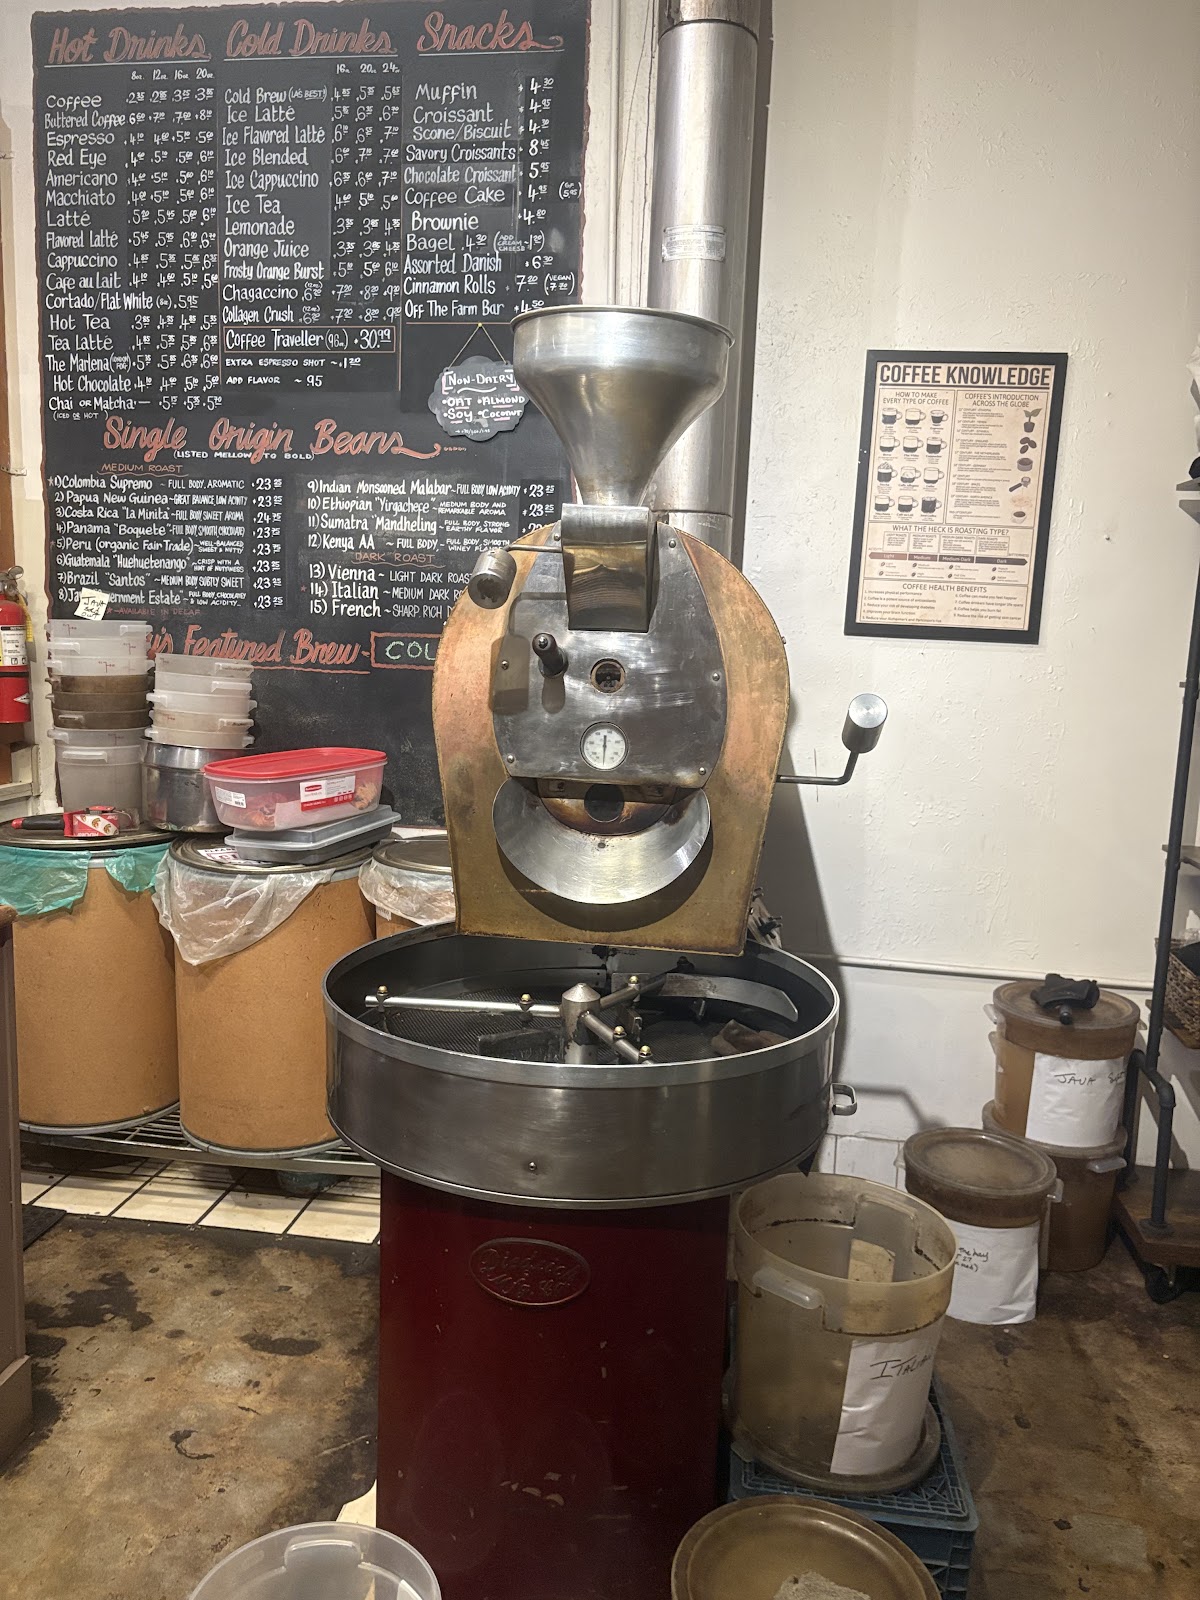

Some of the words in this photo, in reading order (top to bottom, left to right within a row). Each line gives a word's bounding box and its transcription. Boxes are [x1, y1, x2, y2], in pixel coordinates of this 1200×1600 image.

[226, 19, 285, 57] Cold
[289, 17, 397, 56] Drinks
[416, 9, 564, 51] Snacks
[48, 27, 98, 64] Hot
[103, 23, 211, 62] Drinks
[46, 95, 102, 111] Coffee
[224, 88, 251, 104] Cold
[256, 87, 287, 104] Brew
[415, 83, 477, 104] Muffin
[45, 110, 88, 129] Buttered
[92, 110, 125, 128] Coffee
[227, 105, 248, 124] Ice
[413, 102, 494, 124] Croissant
[222, 127, 239, 146] Ice
[244, 125, 289, 145] Flavored
[413, 119, 512, 141] Scone/Biscuit
[47, 132, 114, 149] Espresso
[47, 149, 74, 166] Red
[80, 149, 107, 169] Eye
[224, 149, 246, 167] Ice
[252, 147, 309, 166] Blended
[406, 144, 448, 163] Savory
[451, 141, 517, 161] Croissants
[45, 170, 117, 187] Americano
[225, 170, 245, 189] Ice
[250, 169, 319, 191] Cappuccino
[404, 166, 460, 184] Chocolate
[464, 164, 517, 183] Croissant
[46, 188, 115, 207] Macchiato
[226, 194, 250, 214] Ice
[255, 194, 281, 215] Tea
[405, 187, 458, 209] Coffee
[464, 185, 506, 204] Cake
[47, 210, 91, 227] Latté
[225, 215, 295, 236] Lemonade
[411, 210, 480, 231] Brownie
[224, 237, 269, 259] Orange
[273, 239, 310, 258] Juice
[406, 232, 455, 252] Bagel
[47, 253, 117, 271] Cappuccino
[223, 259, 253, 281] Frosty
[256, 262, 290, 281] Orange
[293, 261, 325, 280] Burst
[403, 253, 456, 275] Assorted
[461, 251, 502, 273] Danish
[46, 273, 75, 293] Cafe
[79, 277, 94, 288] au
[96, 271, 121, 289] Lait
[403, 276, 460, 295] Cinnamon
[464, 274, 496, 295] Rolls
[222, 283, 298, 302] Chagaccino
[222, 306, 260, 325] Collagen
[263, 305, 294, 323] Crush
[405, 299, 424, 319] Off
[427, 300, 449, 317] The
[451, 300, 478, 316] Farm
[482, 299, 504, 316] Bar
[50, 314, 76, 330] Hot
[83, 314, 111, 329] Tea
[48, 334, 70, 351] Tea
[75, 334, 113, 350] Latté
[226, 328, 266, 350] Coffee
[271, 328, 324, 351] Traveller
[45, 355, 65, 372] The
[70, 353, 110, 372] Marlena
[225, 358, 253, 367] EXTRA
[258, 359, 298, 367] ESPRESSO
[303, 358, 326, 367] SHOT
[53, 375, 75, 392] Hot
[77, 374, 131, 392] Chocolate
[226, 376, 243, 385] ADD
[248, 376, 280, 384] FLAVOR
[880, 365, 941, 384] COFFEE
[946, 366, 1051, 386] KNOWLEDGE
[49, 396, 73, 411] Chai
[79, 399, 92, 408] OR
[94, 397, 135, 411] Matcha
[447, 397, 472, 407] OAT
[482, 395, 525, 406] ALMOND
[103, 415, 188, 463] Single
[208, 416, 293, 465] Origin
[309, 418, 435, 458] Beans
[174, 450, 208, 459] (LISTED
[214, 451, 252, 459] MELLOW
[264, 452, 277, 460] TO
[284, 452, 314, 461] BOLD)
[101, 463, 143, 472] MEDIUM
[149, 464, 183, 472] ROAST
[62, 474, 106, 489] Colombia
[110, 475, 153, 493] Supremo
[320, 480, 351, 493] Indian
[357, 480, 406, 494] Monsooned
[410, 479, 452, 495] Malabar
[66, 491, 99, 506] Papua
[103, 492, 126, 504] New
[129, 492, 168, 504] Guinea
[322, 496, 372, 512] Ethiopian
[65, 505, 94, 518] Costa
[97, 506, 119, 519] Rica
[66, 521, 110, 534] Panama
[321, 514, 369, 530] Sumatra
[66, 537, 92, 551] Peru
[95, 537, 139, 552] (organic
[143, 540, 162, 550] Fair
[165, 536, 194, 559] Trade)
[323, 534, 354, 552] Kenya
[359, 534, 375, 549] AA
[65, 553, 110, 568] Guatemala
[355, 552, 385, 561] DARK
[394, 553, 435, 563] ROAST
[66, 571, 99, 586] Brazil
[105, 572, 151, 587] "Santos"
[328, 564, 376, 581] Vienna
[332, 581, 379, 599] Italian
[332, 599, 381, 617] French
[184, 624, 286, 664] Featured
[290, 628, 361, 665] Brew
